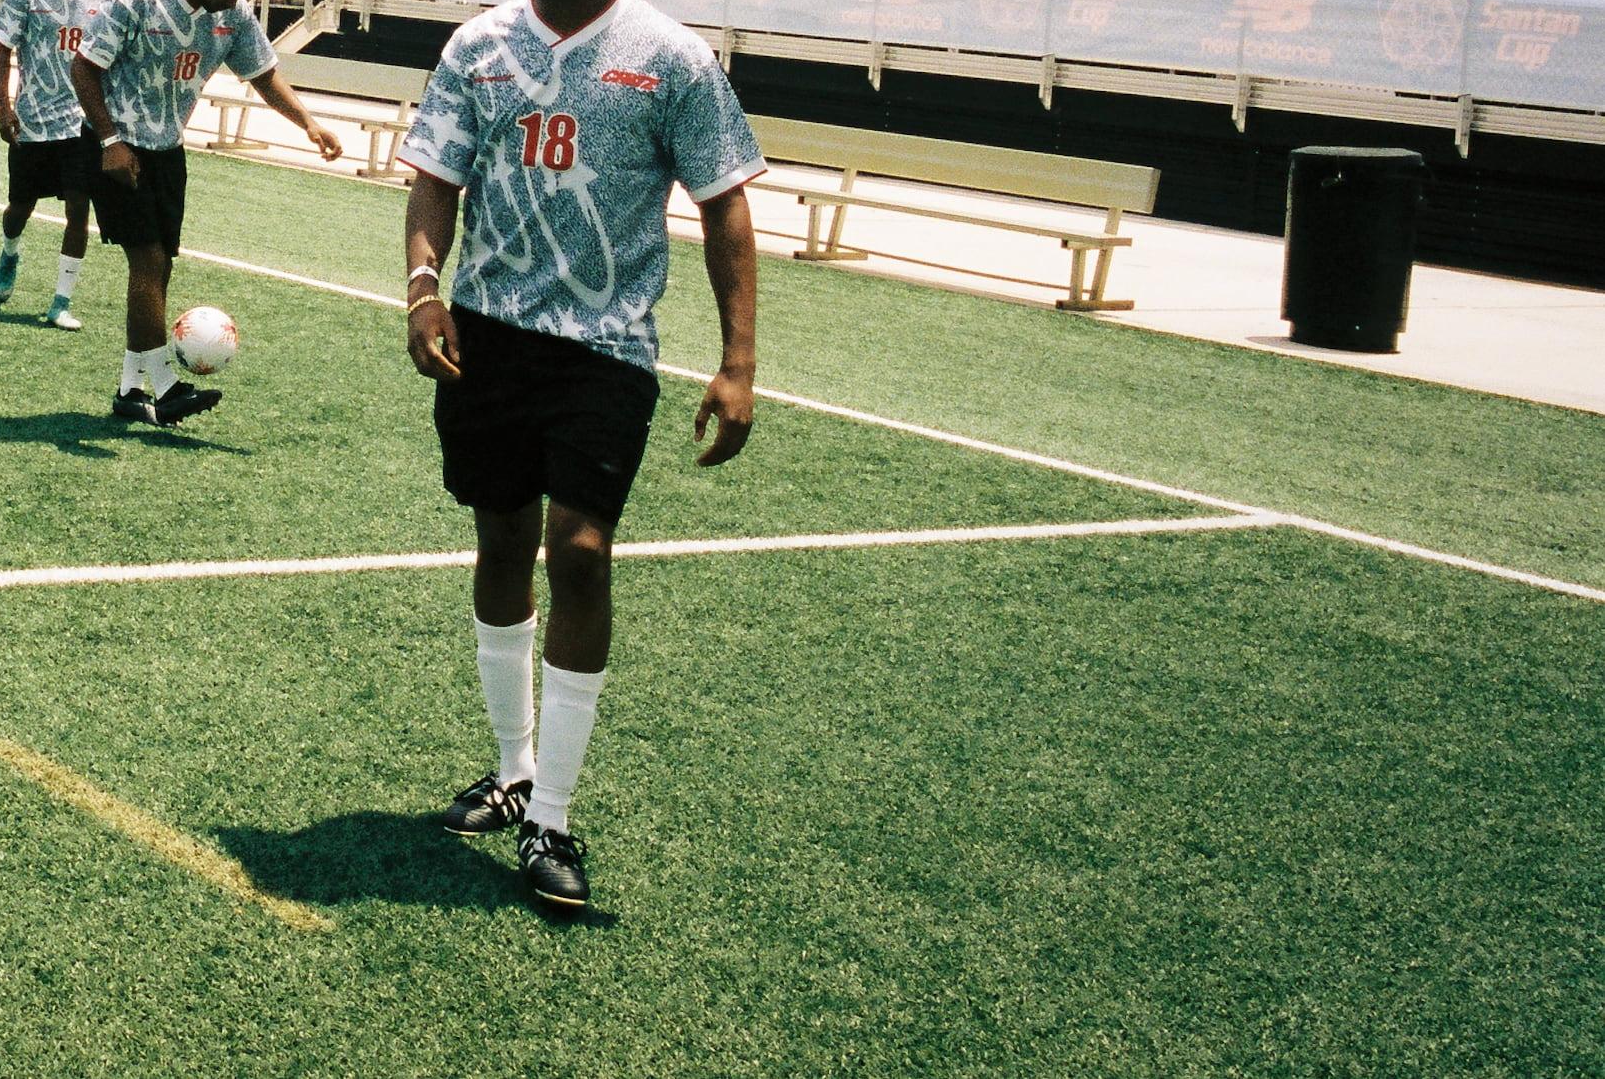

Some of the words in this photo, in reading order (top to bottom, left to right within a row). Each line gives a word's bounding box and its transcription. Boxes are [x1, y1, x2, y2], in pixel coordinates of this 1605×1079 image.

[1478, 0, 1581, 37] Santan
[58, 26, 83, 52] 18
[173, 52, 200, 81] 18
[515, 111, 579, 172] 18
